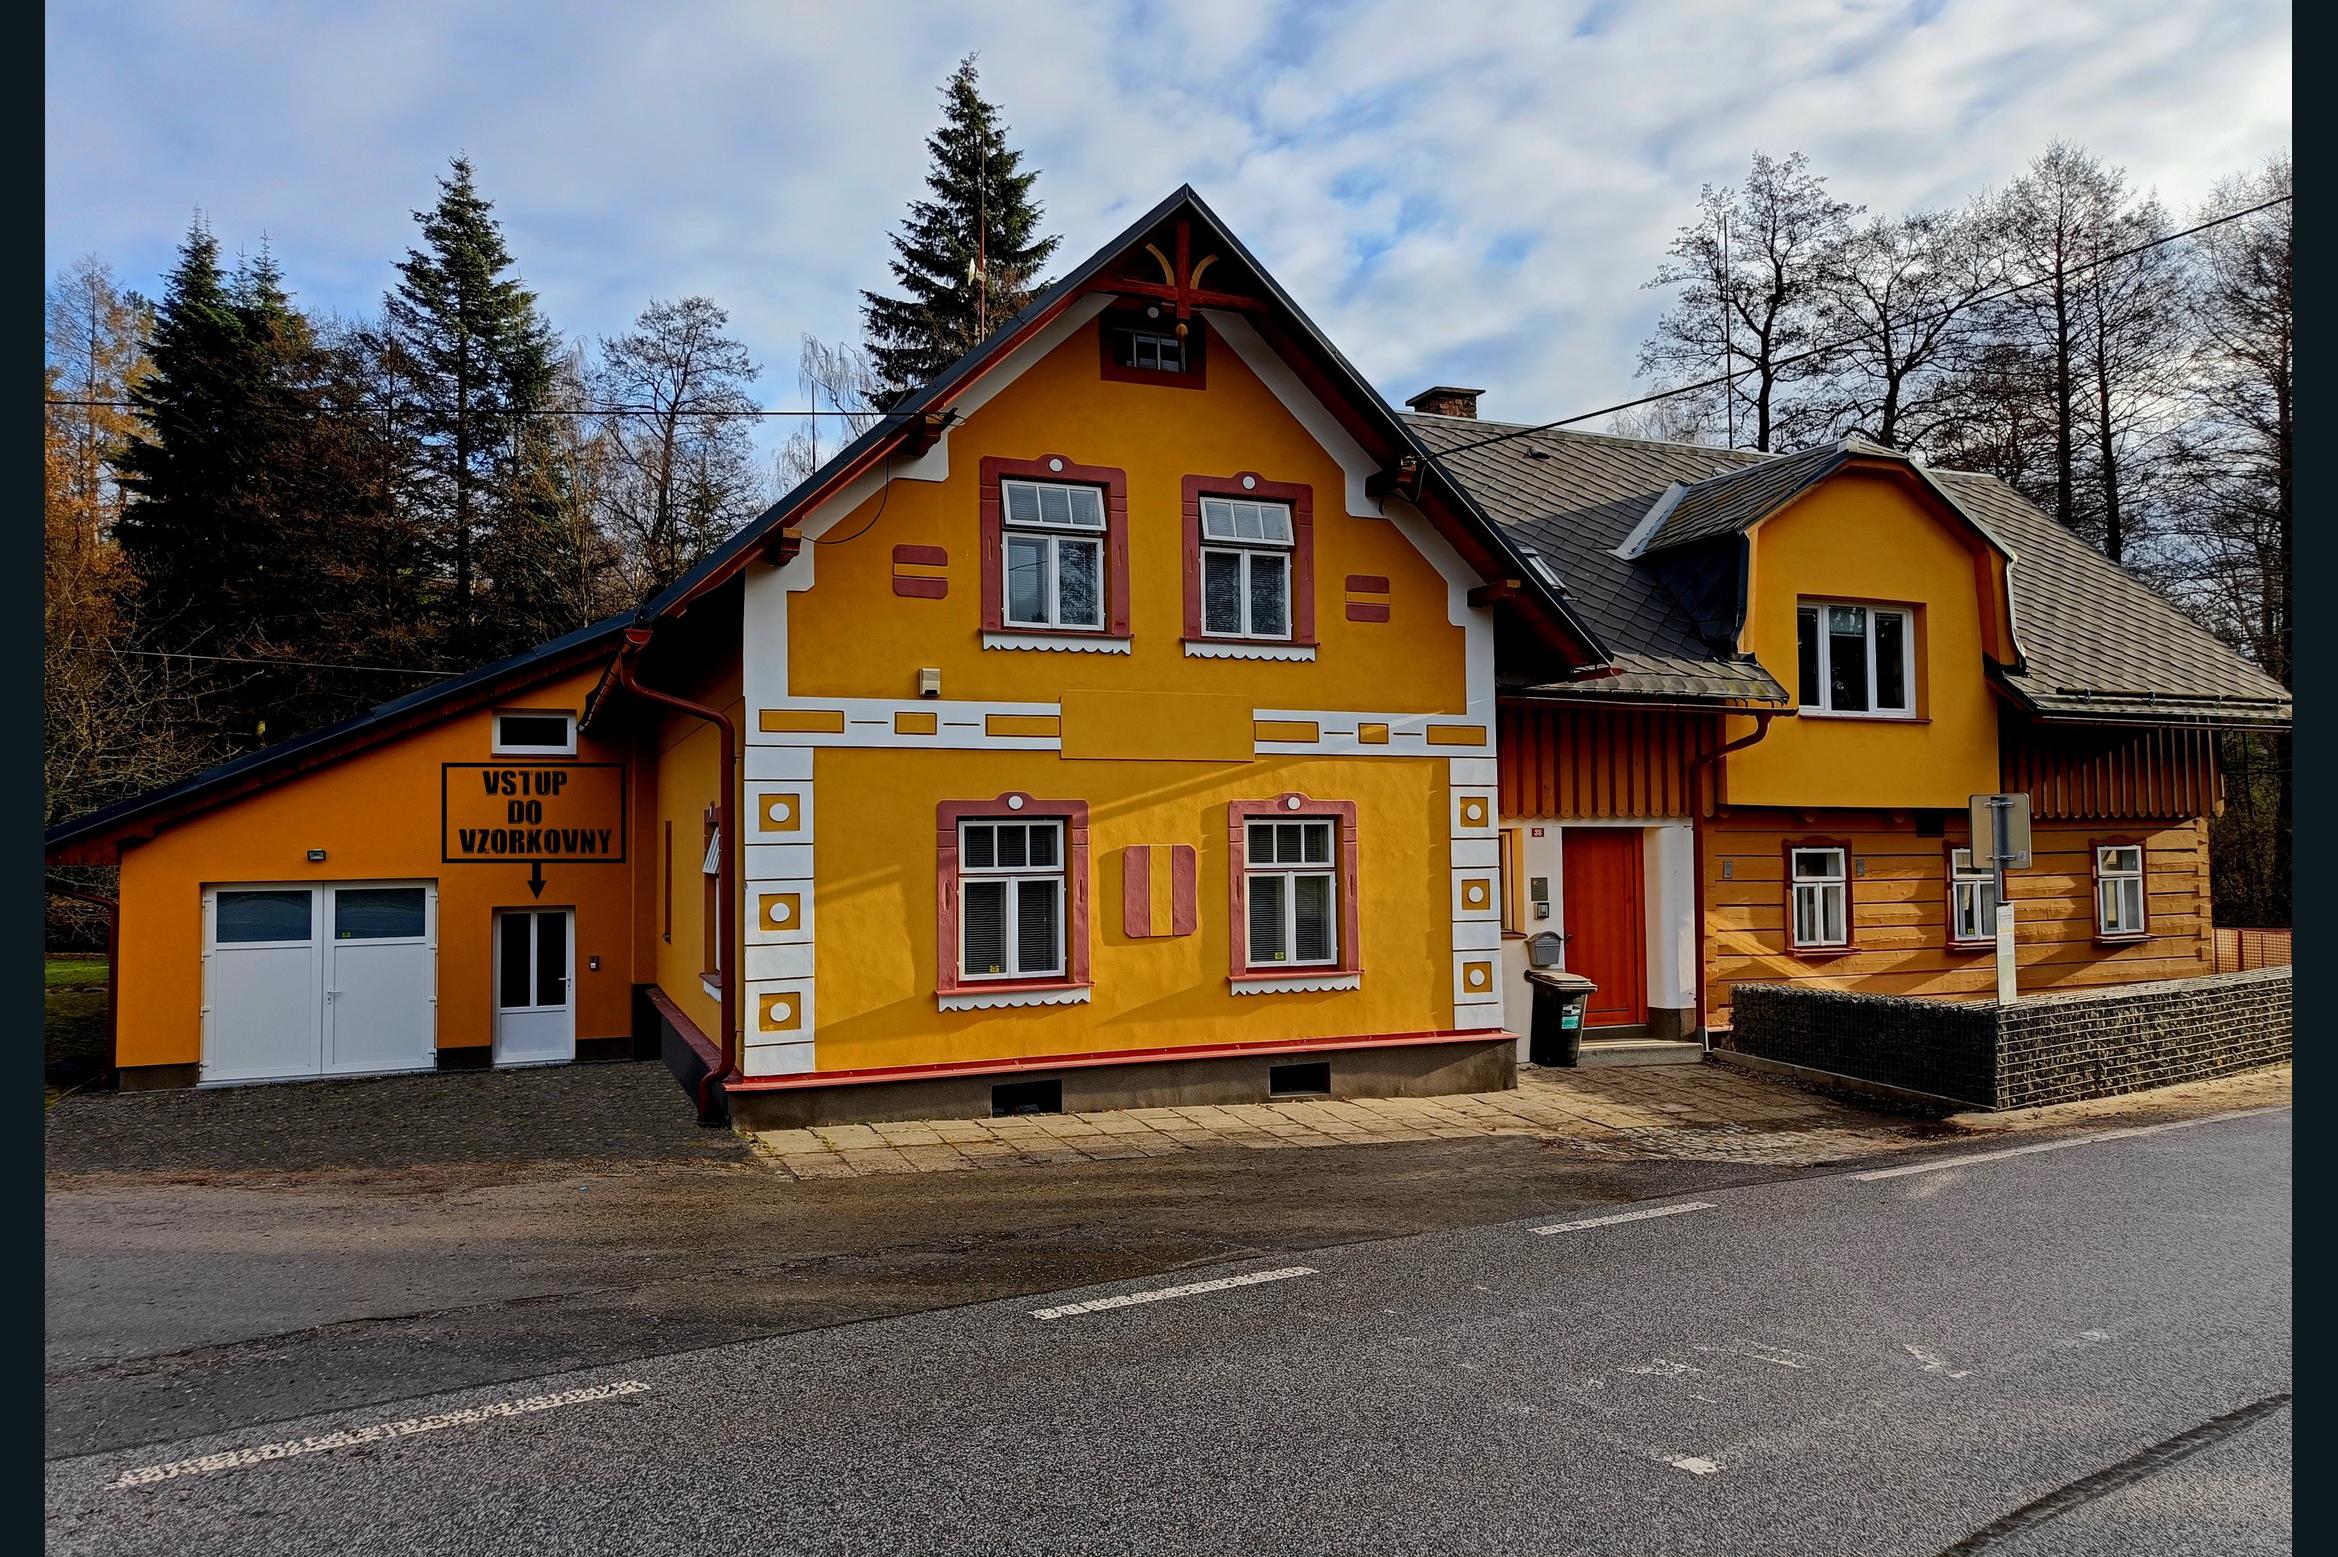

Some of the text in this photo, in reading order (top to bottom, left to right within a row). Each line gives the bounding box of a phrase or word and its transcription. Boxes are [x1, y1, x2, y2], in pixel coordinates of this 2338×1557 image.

[482, 770, 567, 796] VSTUP
[507, 799, 542, 825] DO
[459, 828, 612, 854] VZORKOVNY
